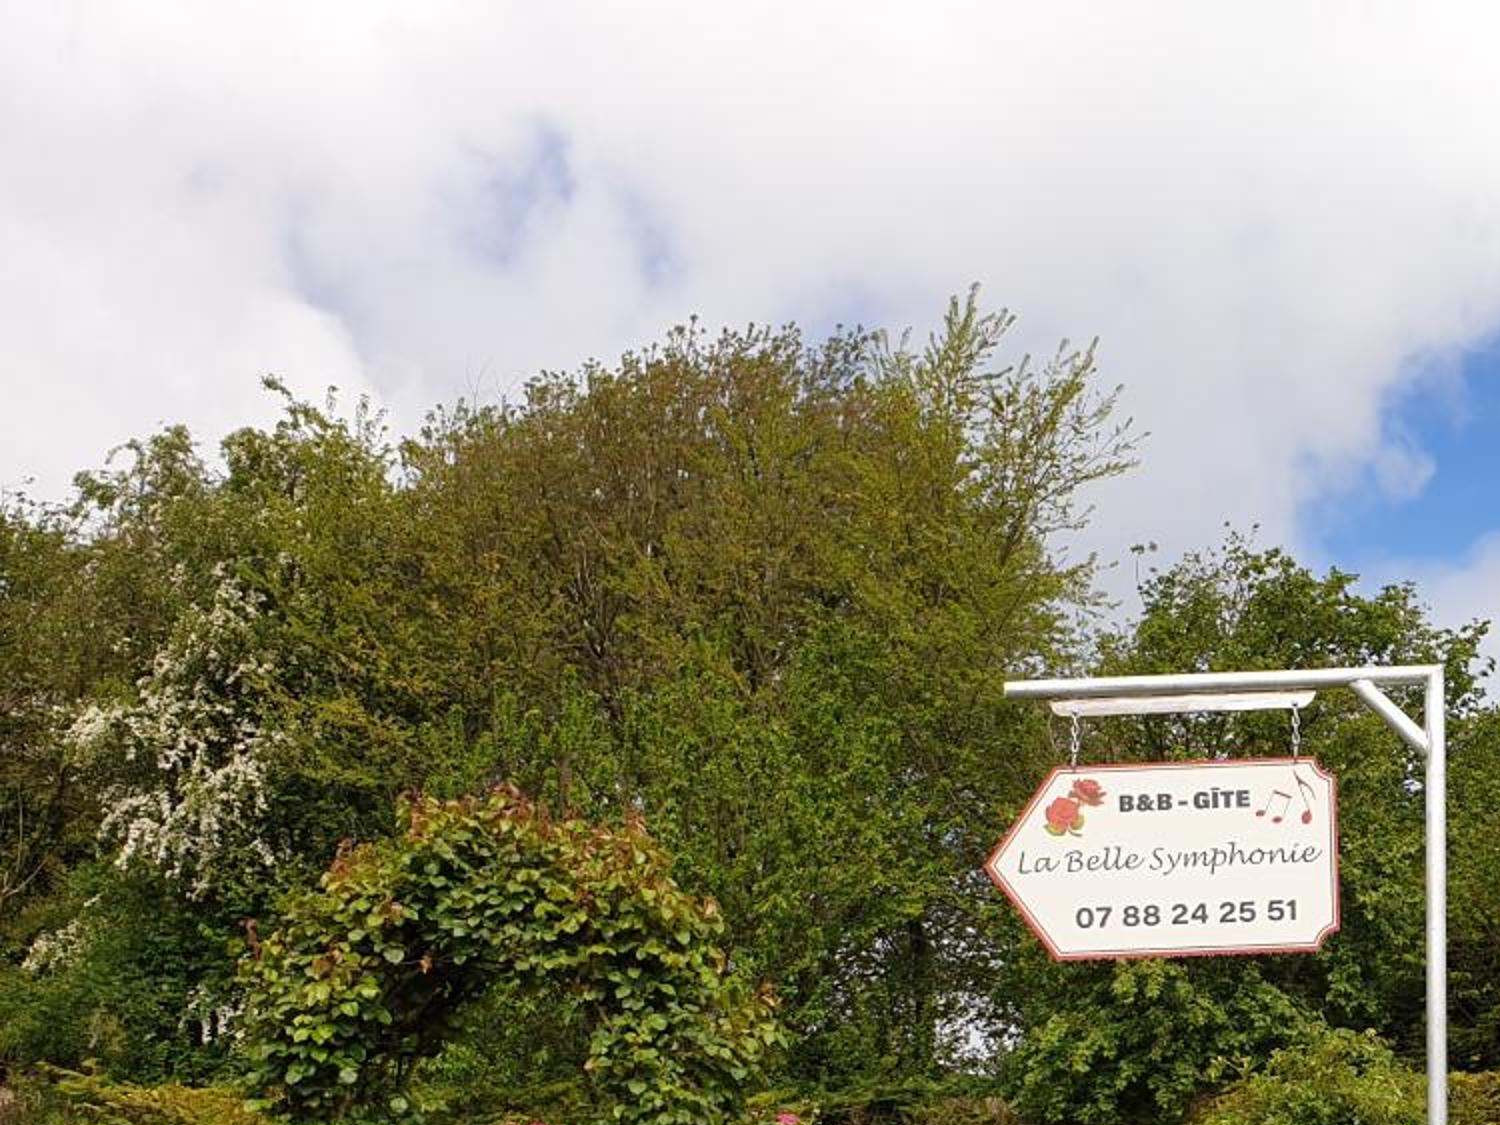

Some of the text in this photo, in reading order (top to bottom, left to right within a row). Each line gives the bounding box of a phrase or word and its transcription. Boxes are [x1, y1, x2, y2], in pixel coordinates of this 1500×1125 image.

[1119, 793, 1173, 812] B&B
[1017, 841, 1323, 876] La Belle Symphonie
[1075, 899, 1297, 929] 07 88 24 25 51
